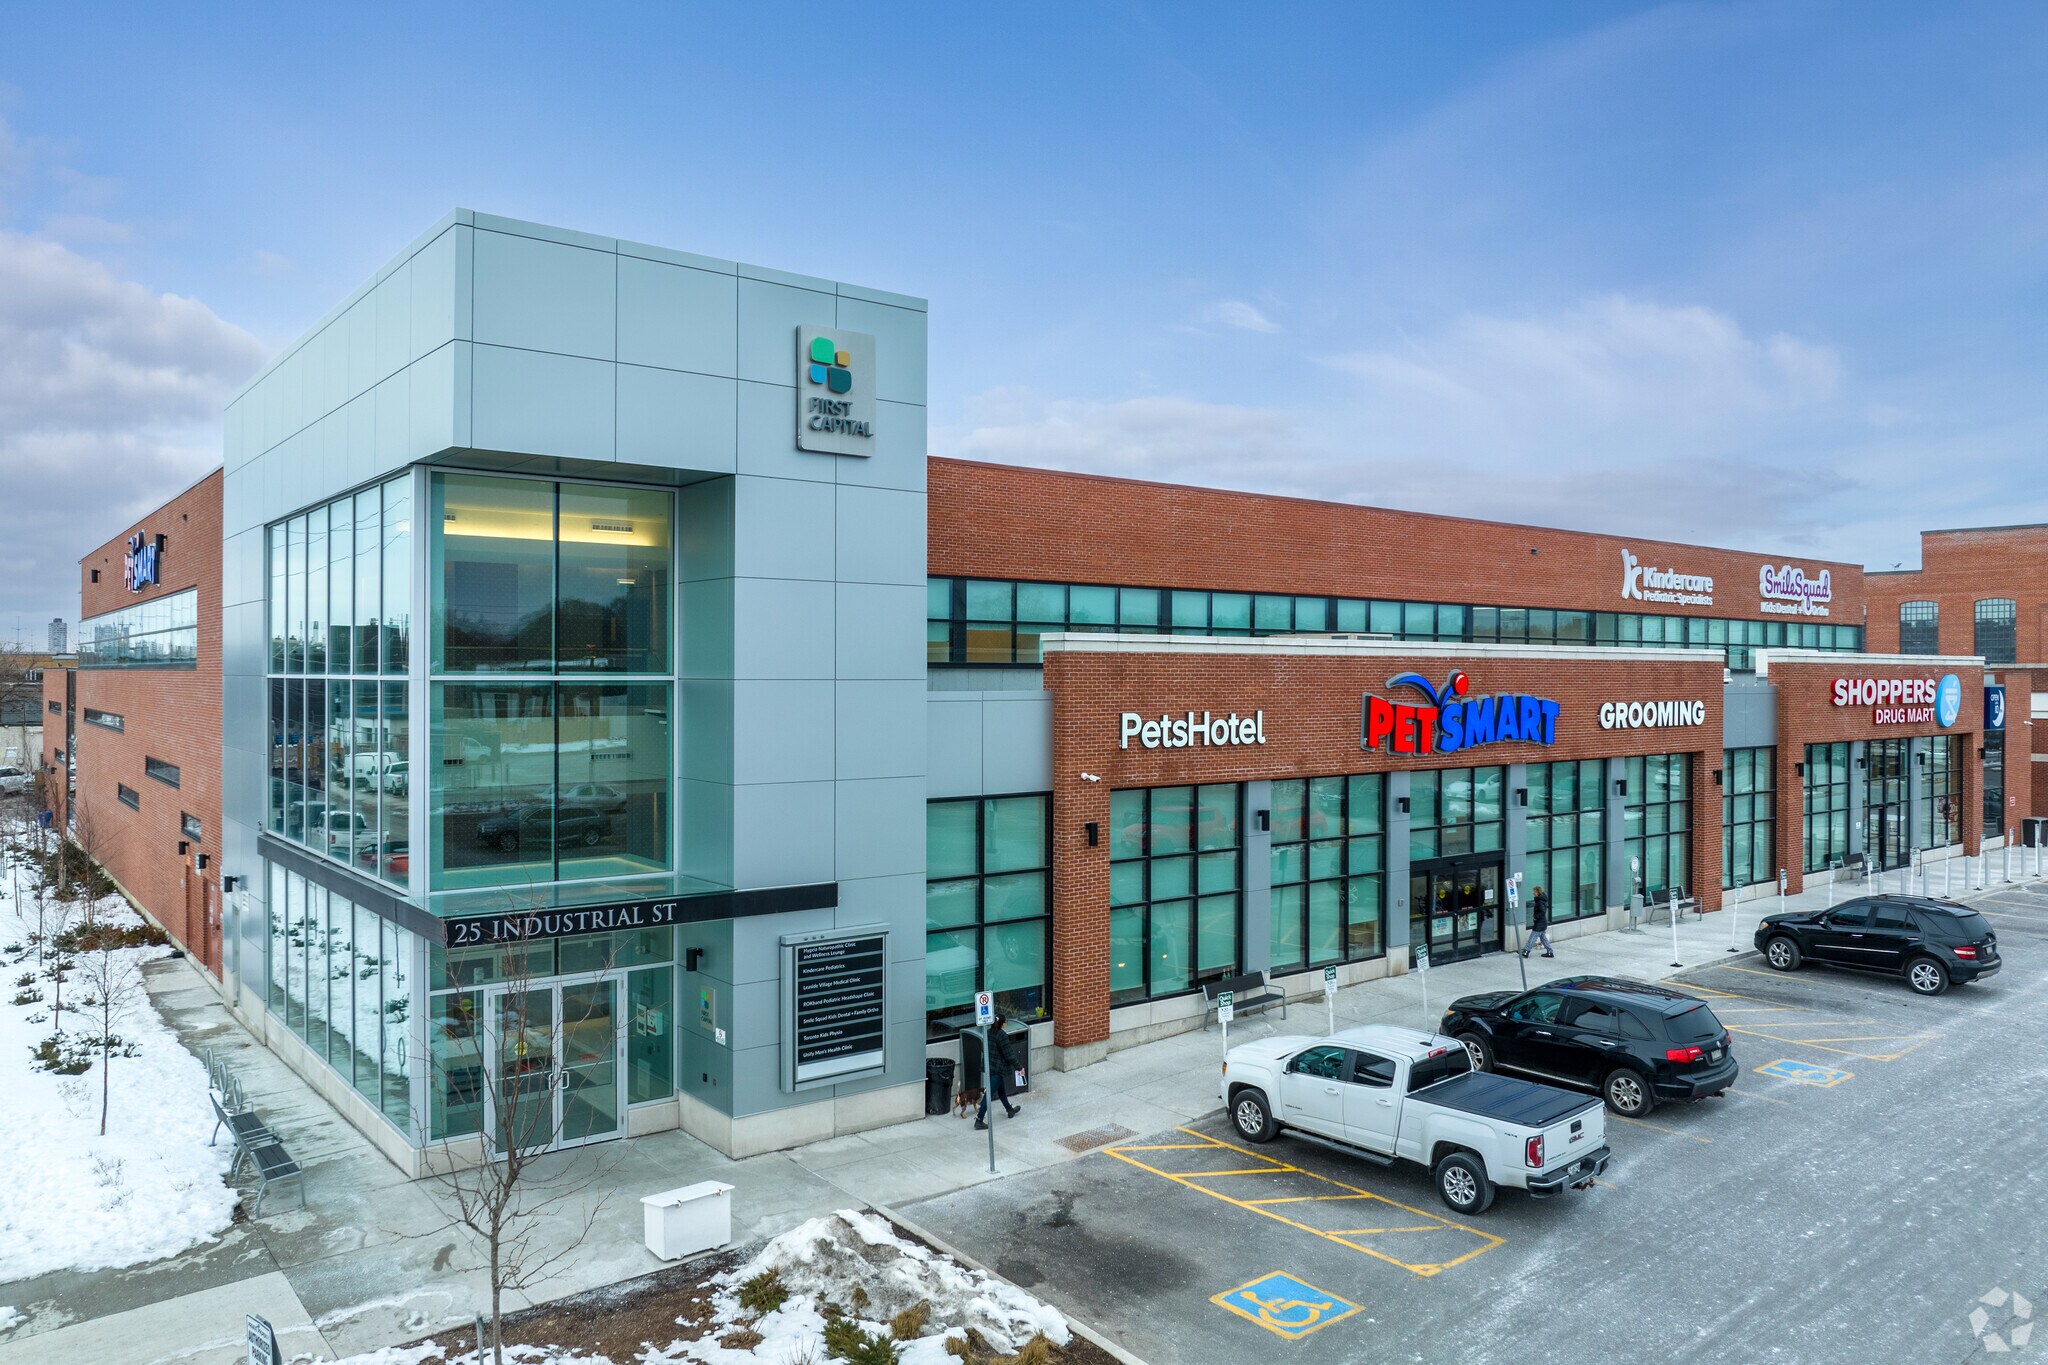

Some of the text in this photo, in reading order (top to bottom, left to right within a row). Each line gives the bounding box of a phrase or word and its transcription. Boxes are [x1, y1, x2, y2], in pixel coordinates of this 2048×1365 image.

[809, 396, 853, 417] FIRST
[809, 415, 874, 438] CAPITAL
[1643, 566, 1713, 593] Kindercare
[1765, 568, 1830, 611] SmileSquad
[1832, 678, 1936, 706] SHOPPERS
[1366, 692, 1561, 754] PETSMART
[1599, 700, 1706, 730] GROOMING
[1875, 707, 1935, 725] DRUG MART
[1120, 711, 1266, 749] PetsHotel
[454, 903, 678, 944] 25 INDUSTRIAL ST
[803, 966, 825, 974] Kindercare
[833, 978, 849, 986] Medical
[803, 1033, 819, 1041] Toronto
